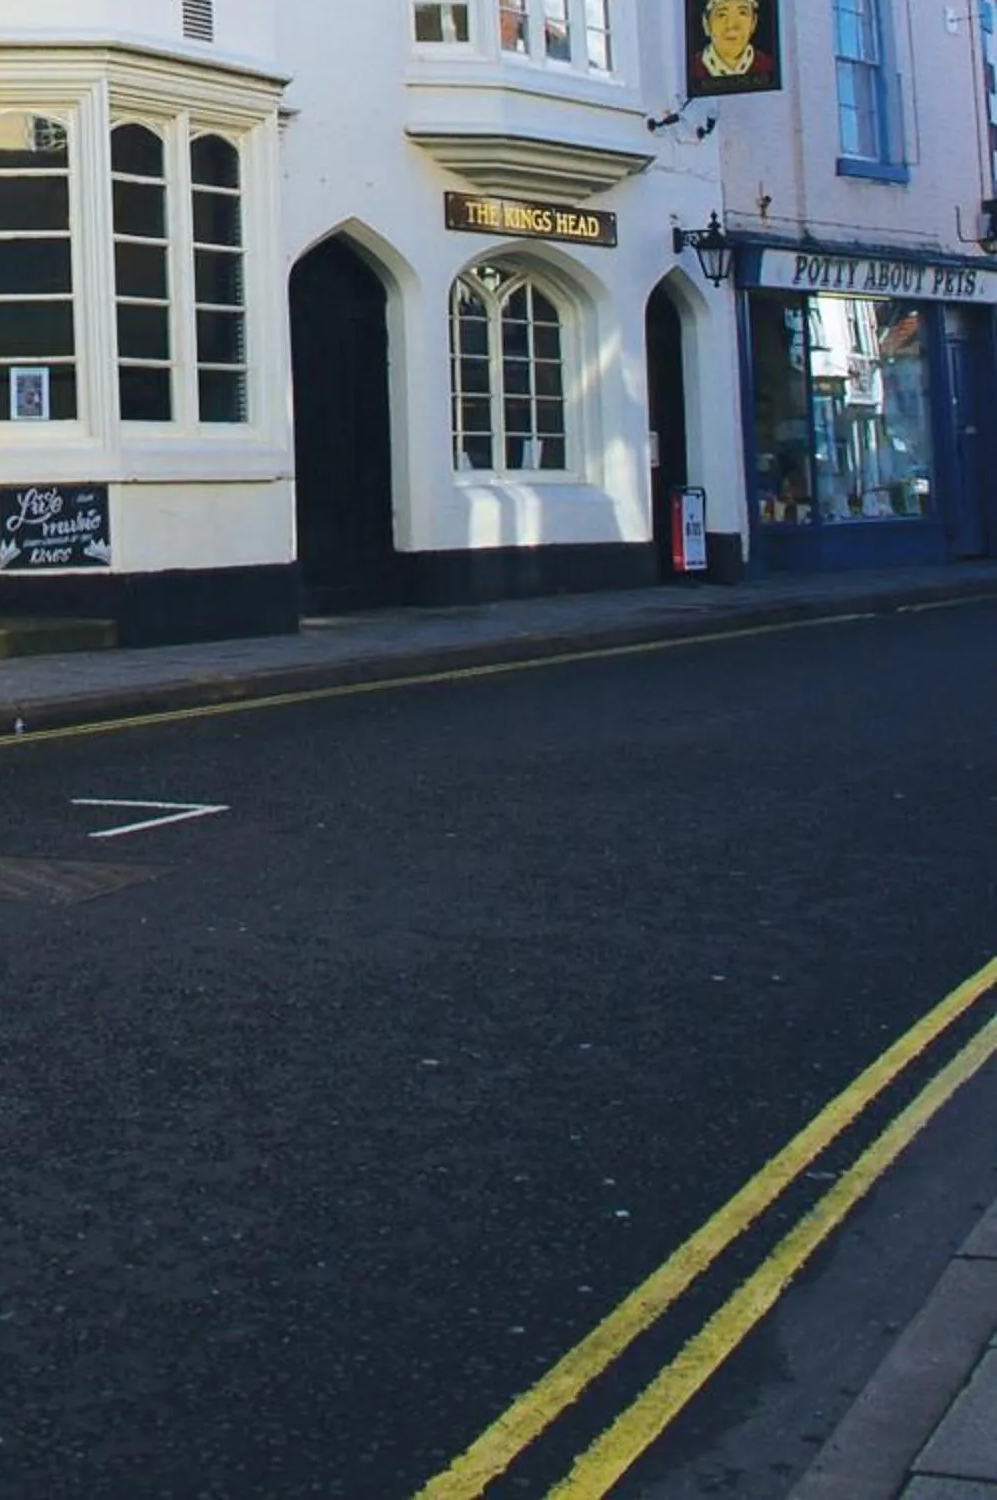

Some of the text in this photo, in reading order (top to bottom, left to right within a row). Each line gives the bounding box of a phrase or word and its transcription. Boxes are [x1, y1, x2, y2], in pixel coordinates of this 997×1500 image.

[464, 201, 600, 237] THE KINGS HEAD
[792, 255, 977, 297] POTTY ABOUT PETS
